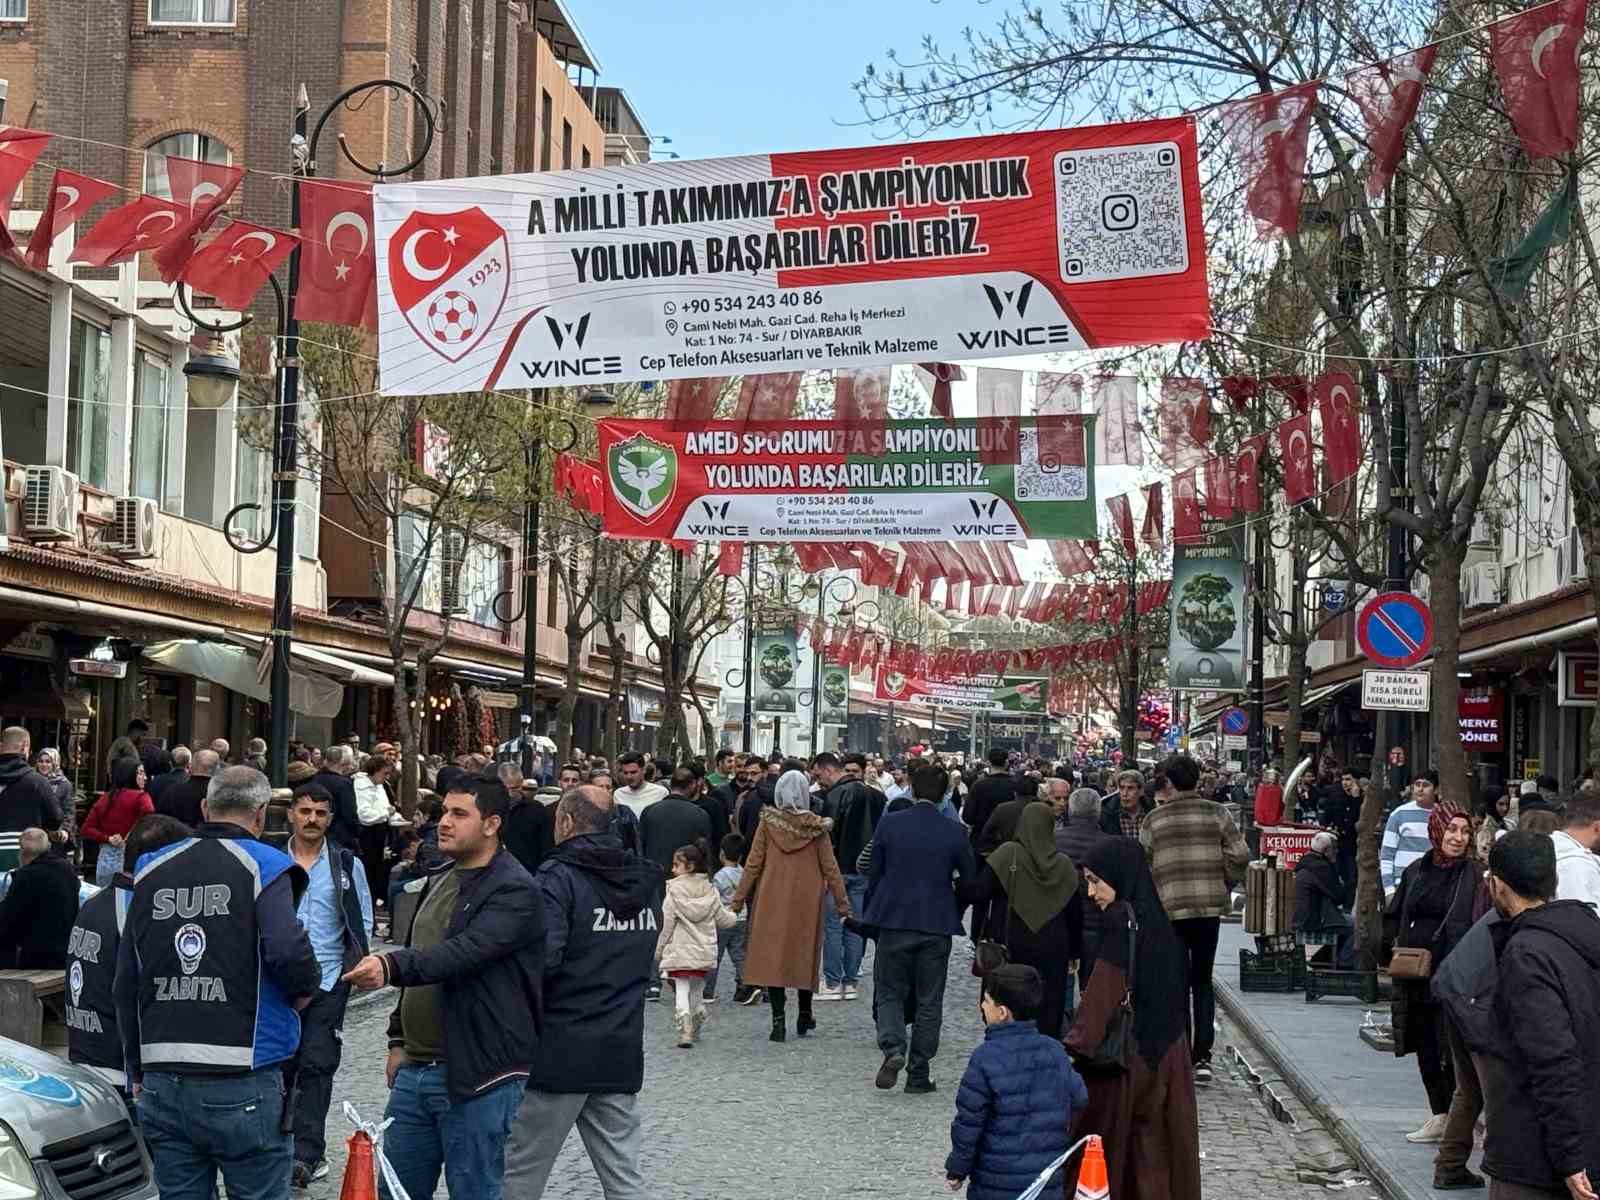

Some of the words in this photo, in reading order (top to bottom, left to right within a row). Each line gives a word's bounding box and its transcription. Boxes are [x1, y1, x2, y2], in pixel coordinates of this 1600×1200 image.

[527, 199, 548, 236] A
[554, 183, 628, 234] MİLLİ
[633, 174, 808, 227] TAKIMIMIZ'A
[820, 156, 1031, 221] ŞAMPİYONLUK
[571, 242, 699, 284] YOLUNDA
[706, 222, 867, 277] BAŞARILAR
[873, 208, 988, 264] DİLERİZ.
[467, 256, 504, 289] 1923
[682, 299, 710, 314] +90
[714, 296, 742, 312] 534
[747, 294, 775, 310] 243
[780, 292, 798, 307] 40
[803, 291, 823, 305] 86
[683, 320, 710, 333] Cami
[712, 319, 737, 331] Nebi
[740, 317, 766, 329] Mah.
[768, 314, 791, 327] Gazi
[794, 312, 817, 325] Cad.
[821, 310, 847, 323] Reha
[849, 307, 859, 322] İş
[862, 306, 905, 319] Merkezi
[685, 336, 706, 347] Kat:
[708, 335, 715, 346] 1
[718, 334, 737, 345] No:
[739, 332, 753, 344] 74
[762, 331, 780, 342] Sur
[790, 325, 862, 340] DİYARBAKIR
[957, 325, 1069, 350] WINCE
[640, 355, 666, 371] Cep
[668, 352, 717, 369] Telefon
[720, 346, 804, 366] Aksesuarları
[806, 347, 823, 359] ve
[826, 341, 872, 358] Teknik
[875, 338, 939, 354] Malzeme
[520, 356, 622, 380] WINCE
[685, 431, 738, 455] AMED
[870, 424, 1009, 457] ŞAMPİYONLUK
[703, 464, 795, 489] YOLUNDA
[799, 462, 909, 490] BAŞARILAR
[911, 458, 990, 487] DİLERİZ.
[787, 497, 805, 507] +90
[807, 497, 825, 506] 534
[827, 496, 846, 506] 243
[847, 496, 860, 505] 40
[861, 496, 874, 505] 86
[687, 525, 750, 536] WINCE
[760, 528, 776, 537] Cep
[778, 527, 808, 536] Telefon
[874, 526, 901, 535] Teknik
[903, 526, 942, 535] Malzeme
[952, 524, 1017, 535] WINCE
[1370, 686, 1390, 694] KISA
[1387, 675, 1418, 684] DAKİKA
[1458, 719, 1498, 728] MERVE
[152, 884, 232, 921] SUR
[67, 926, 102, 964] SUR
[153, 976, 228, 1003] ZABITA
